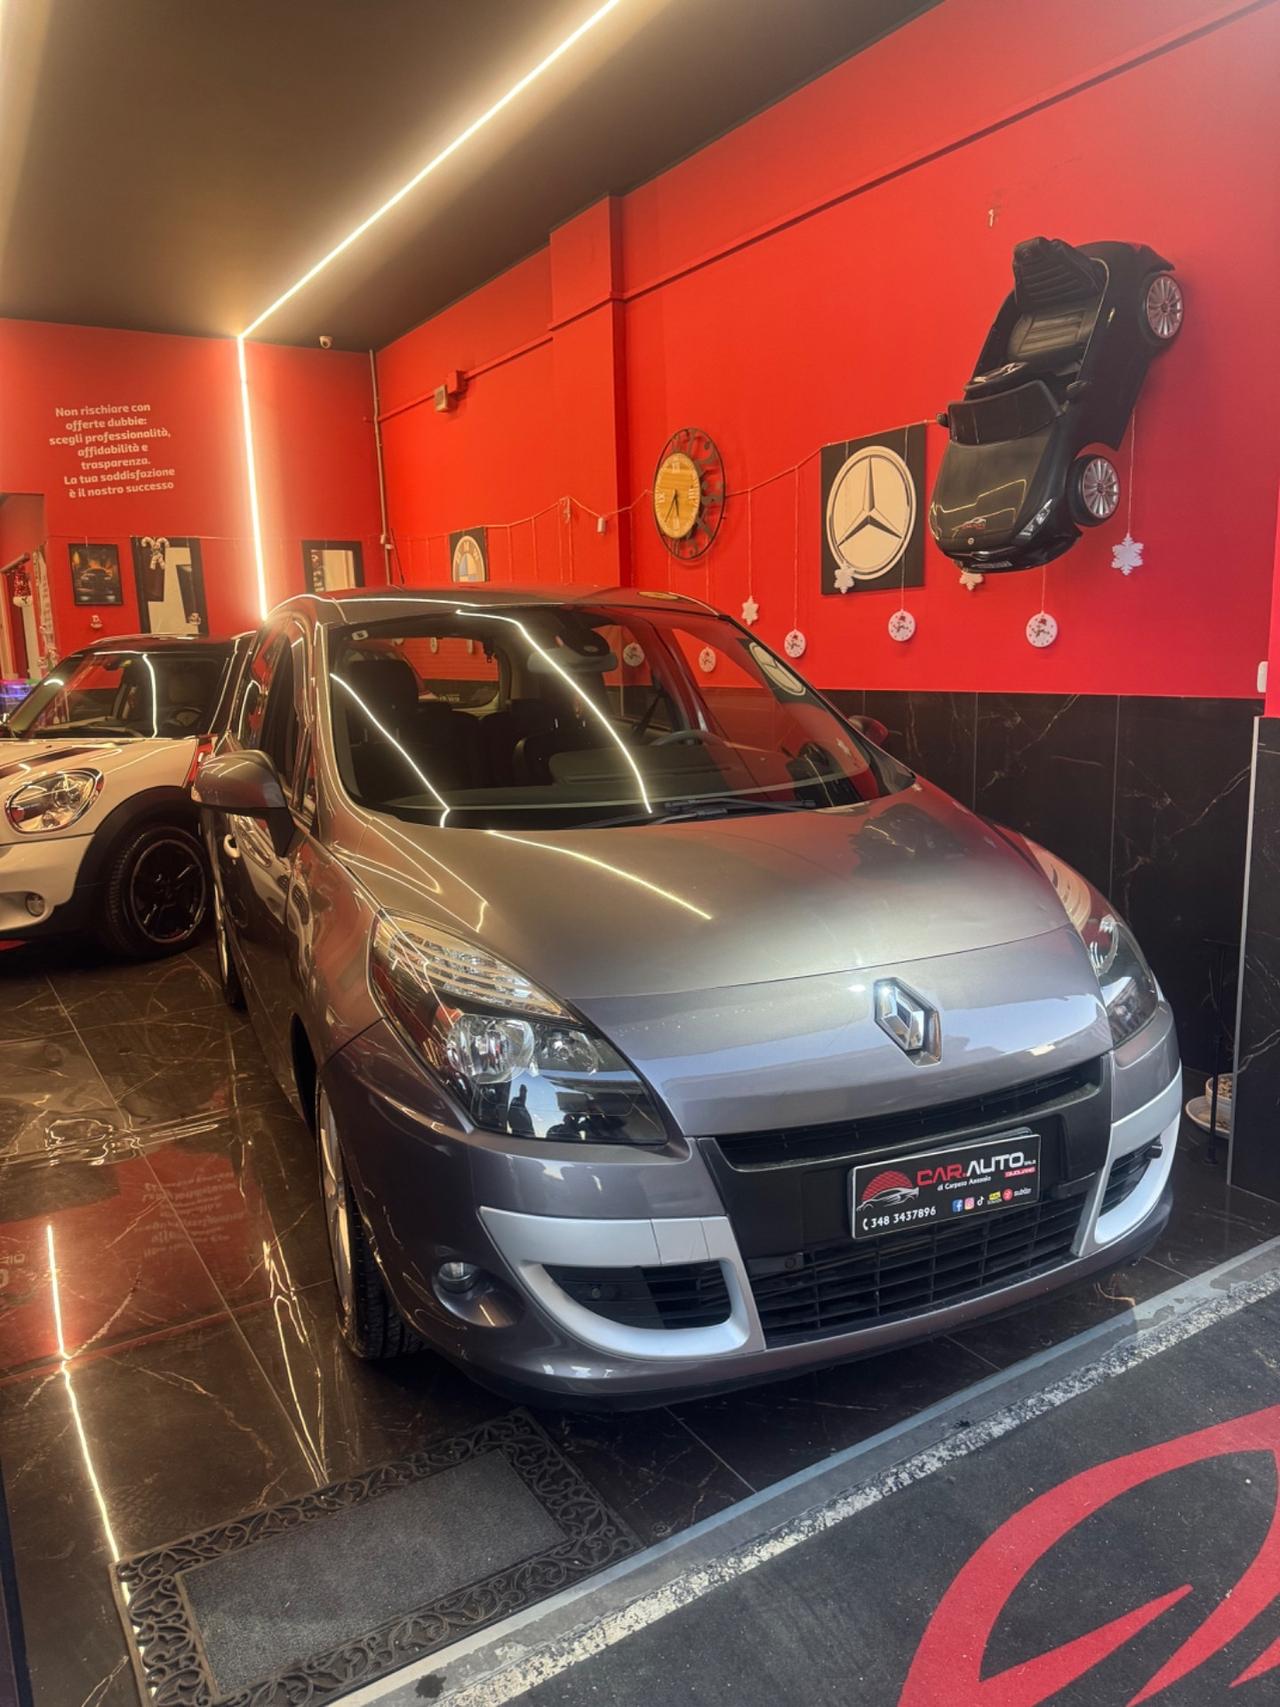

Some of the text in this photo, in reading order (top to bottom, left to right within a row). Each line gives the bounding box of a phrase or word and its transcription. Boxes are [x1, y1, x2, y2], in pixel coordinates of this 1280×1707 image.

[55, 404, 151, 417] Non rischiare con
[65, 416, 147, 432] offerte dubbie:
[49, 427, 171, 446] scegli professionalità,
[77, 443, 140, 458] affidabilità
[81, 457, 151, 470] trasparenza.
[63, 468, 175, 485] La tua soddisfazione
[68, 481, 175, 498] è il nostro successo
[870, 1206, 937, 1228] 348 3437896
